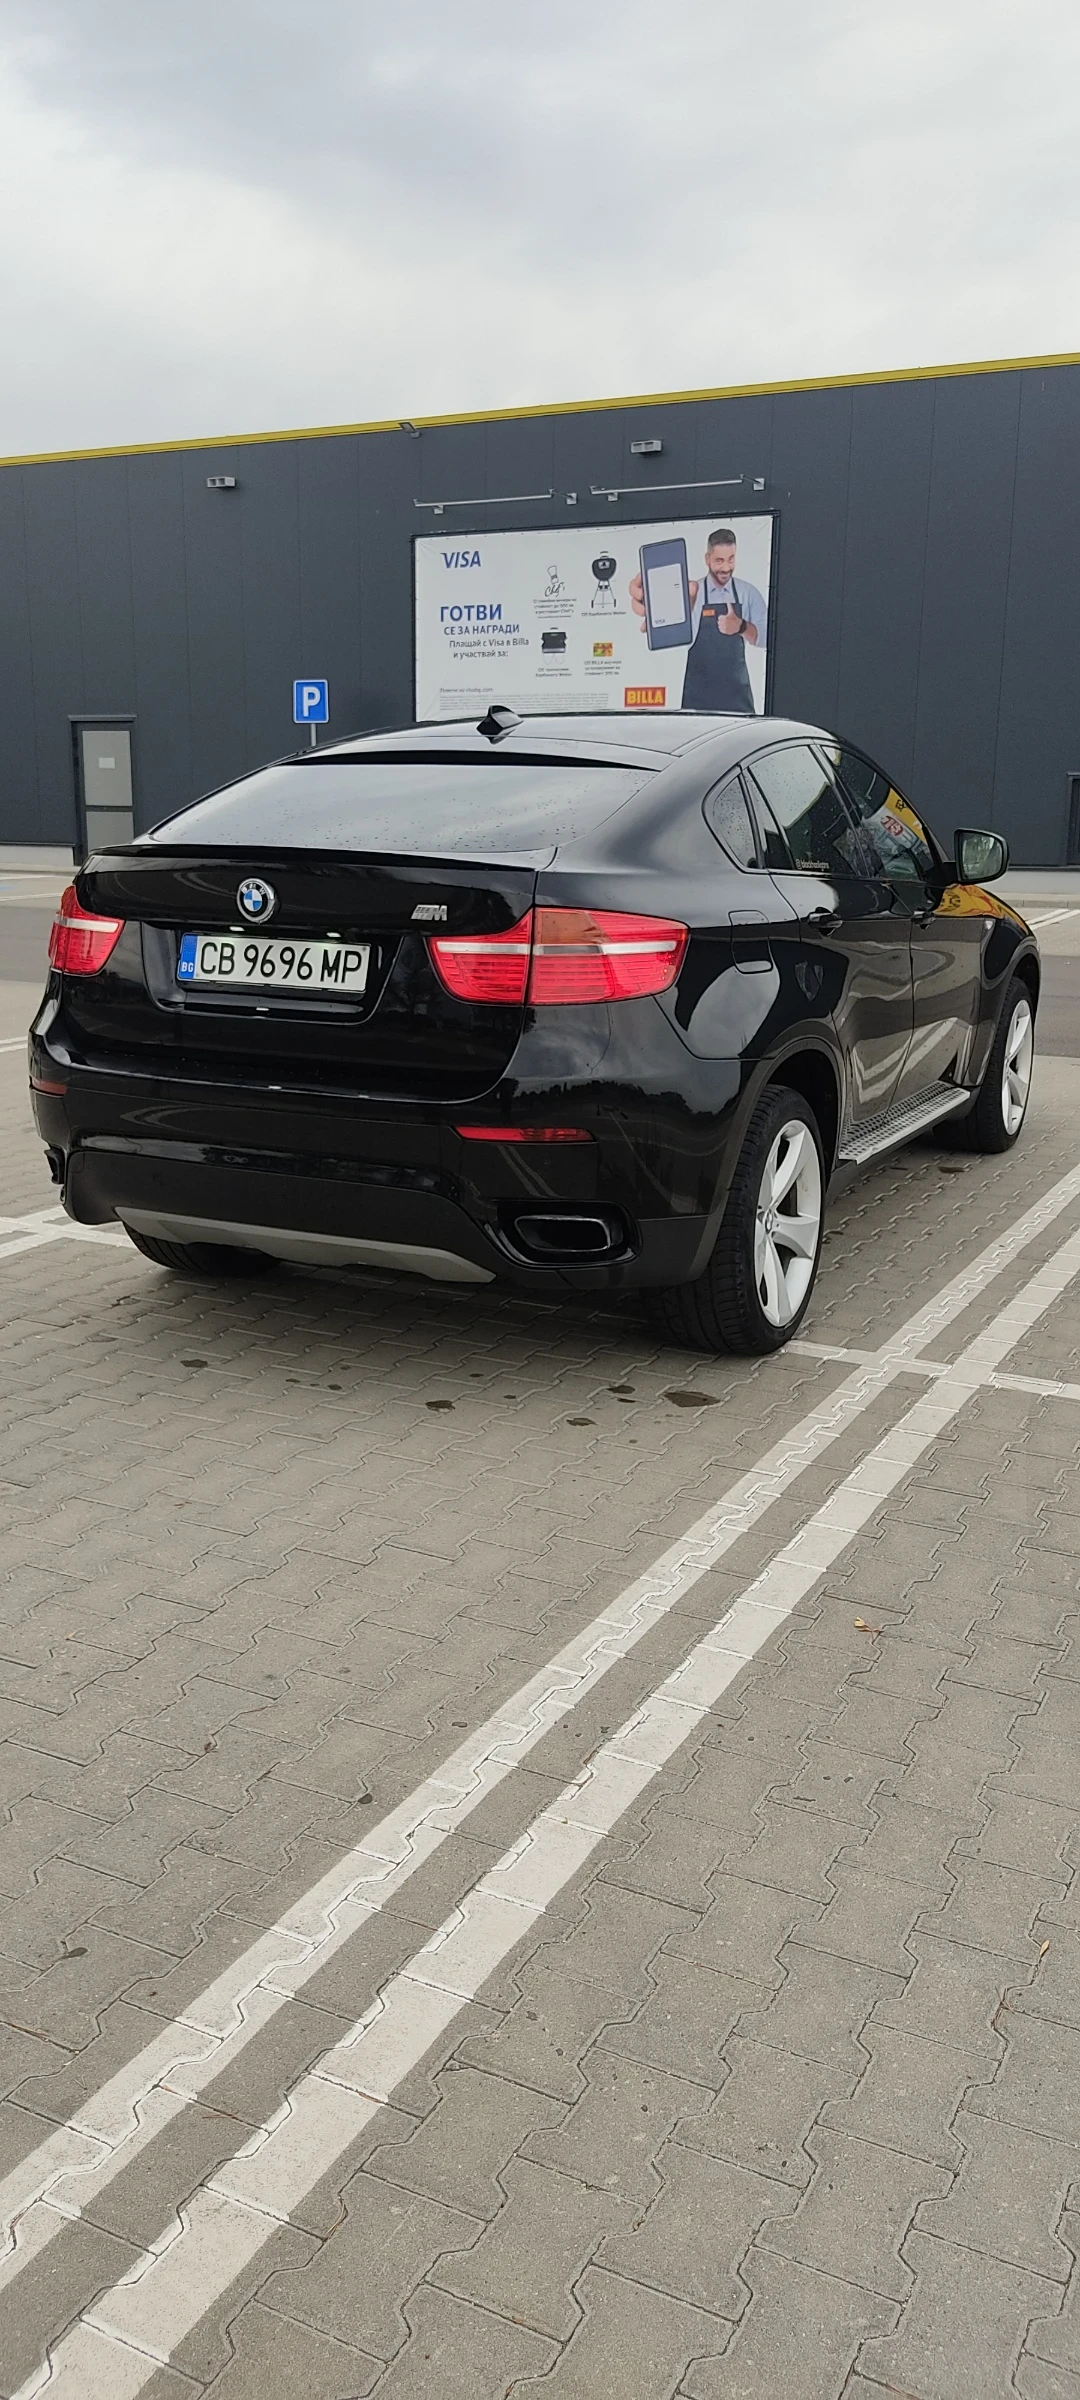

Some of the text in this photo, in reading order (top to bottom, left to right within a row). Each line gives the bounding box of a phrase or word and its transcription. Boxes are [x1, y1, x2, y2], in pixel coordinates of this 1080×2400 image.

[440, 550, 481, 569] VISA
[440, 603, 502, 622] ГОТВИ
[443, 624, 520, 636] СЕ ЗА НАГРАДИ
[449, 639, 481, 648] Плащай
[488, 639, 504, 647] Visa
[512, 637, 529, 646] Billa
[459, 650, 496, 660] участвай
[303, 686, 321, 717] P
[626, 690, 664, 704] BILLA
[241, 883, 267, 896] BMW
[180, 962, 194, 973] BG
[243, 944, 313, 981] 9696
[320, 949, 362, 984] MP
